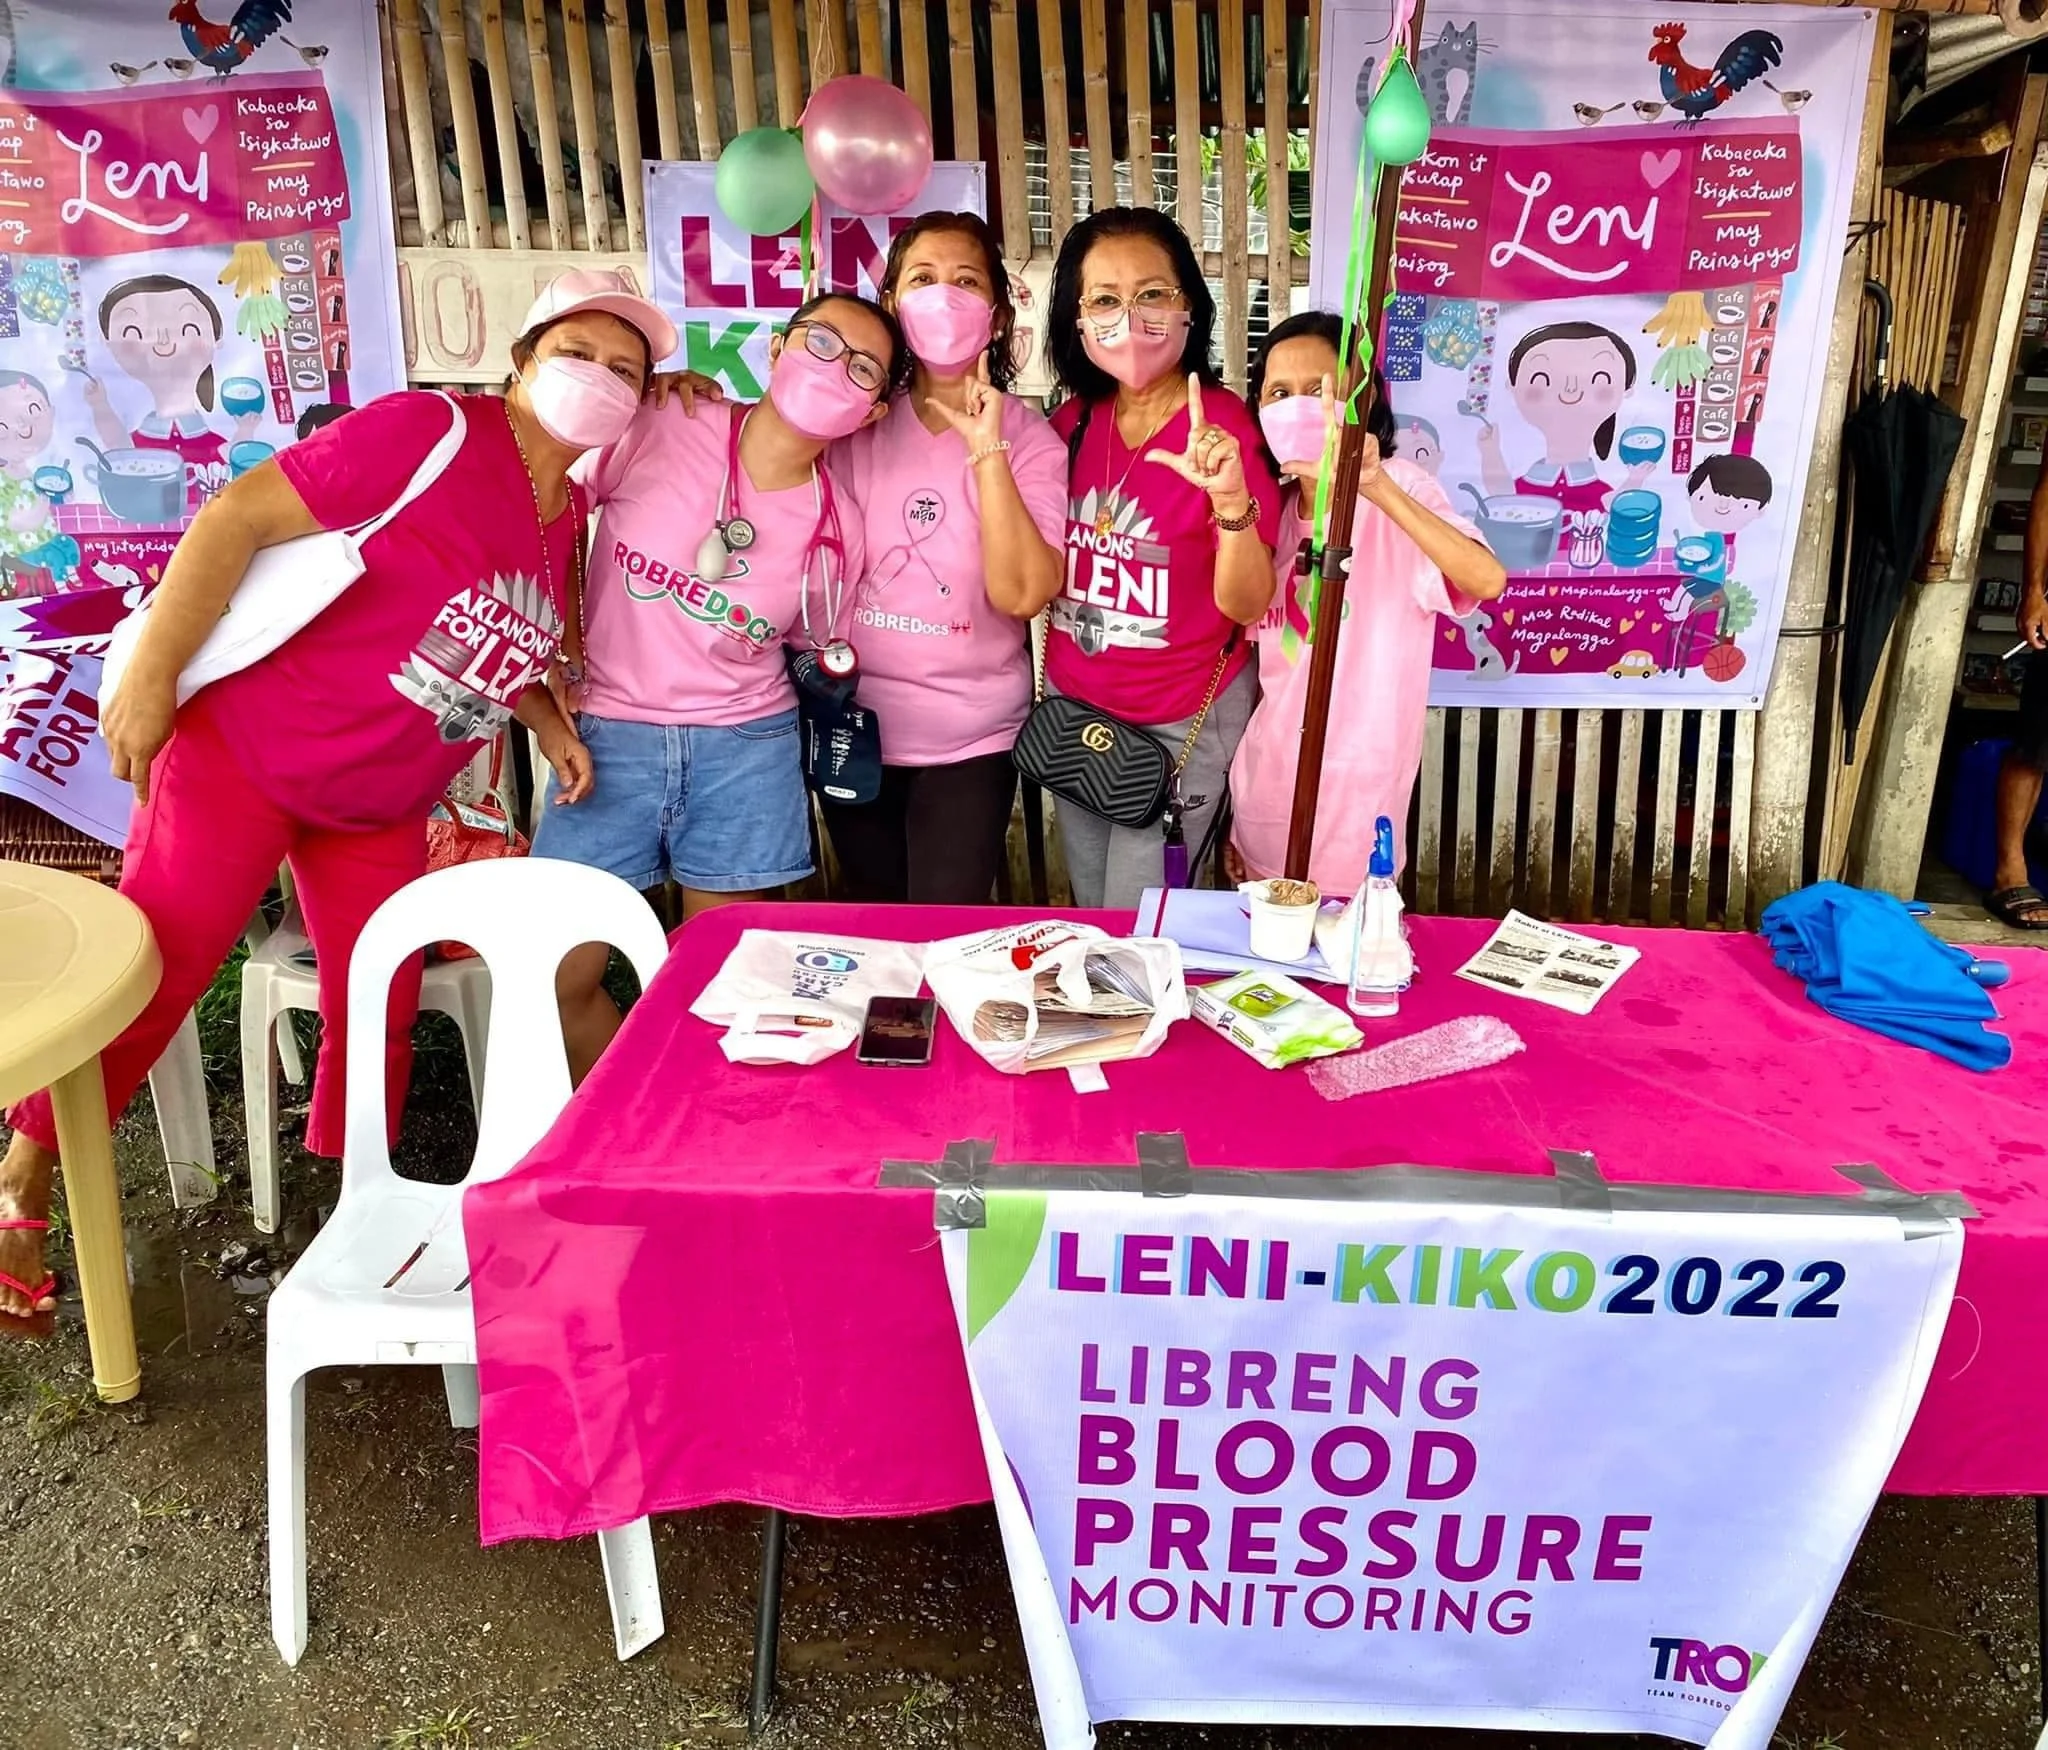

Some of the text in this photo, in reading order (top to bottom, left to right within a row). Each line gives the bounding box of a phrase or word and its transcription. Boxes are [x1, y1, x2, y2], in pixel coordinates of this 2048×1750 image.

[56, 129, 209, 235] Leni
[268, 174, 310, 197] May
[1489, 170, 1660, 282] Leni
[1715, 224, 1762, 248] May
[1065, 524, 1135, 561] ANONS
[1066, 547, 1169, 617] LENI
[433, 605, 488, 649] FOR
[447, 587, 554, 657] AKLANONS
[26, 713, 98, 788] FOR
[1080, 1343, 1481, 1421] LIBRENG
[1077, 1414, 1478, 1500] BLOOD
[1073, 1497, 1653, 1583] PRESSURE
[1068, 1574, 1534, 1636] MONITORING
[1647, 1688, 1732, 1712] TEAM ROBREDO
